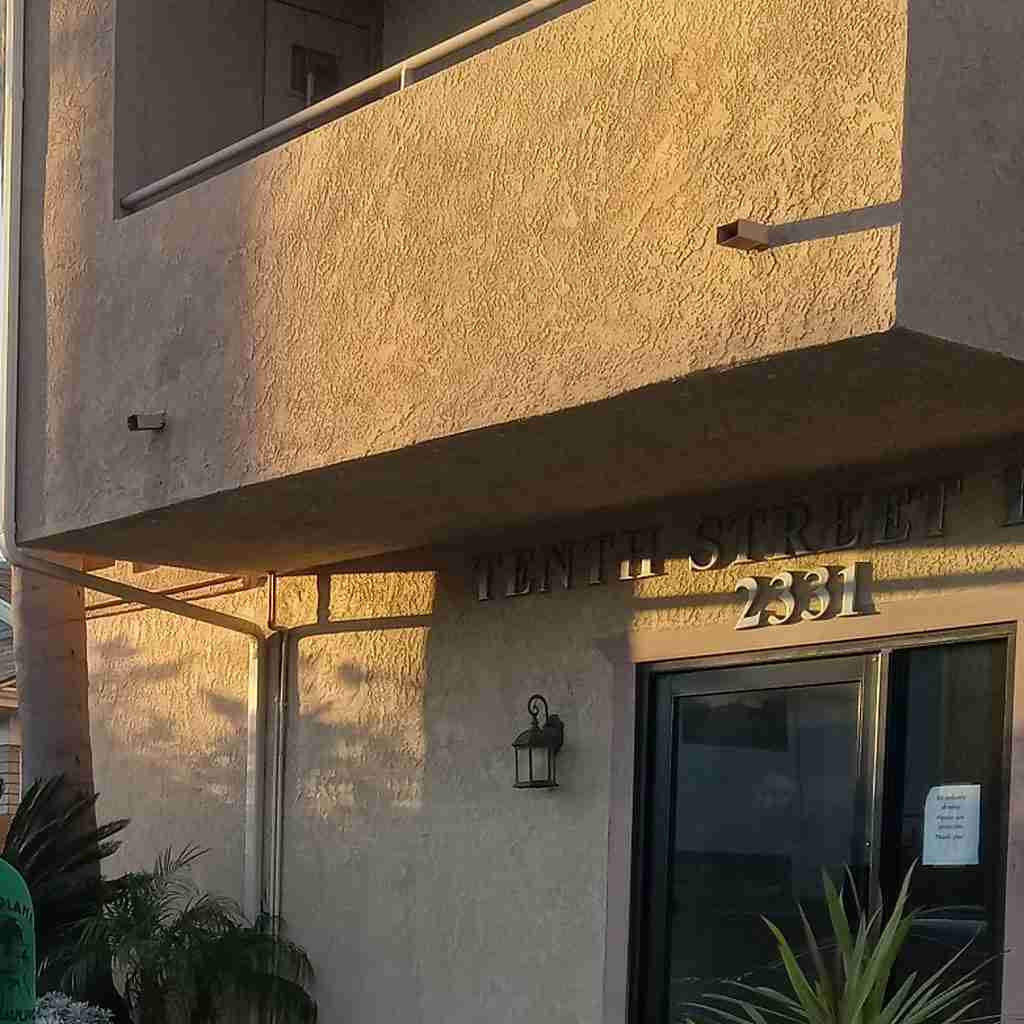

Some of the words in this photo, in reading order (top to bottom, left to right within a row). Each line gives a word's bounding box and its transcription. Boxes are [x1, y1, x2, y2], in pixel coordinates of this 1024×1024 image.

[473, 524, 660, 601] TENTH
[690, 477, 963, 571] STREET
[734, 561, 864, 630] 2331
